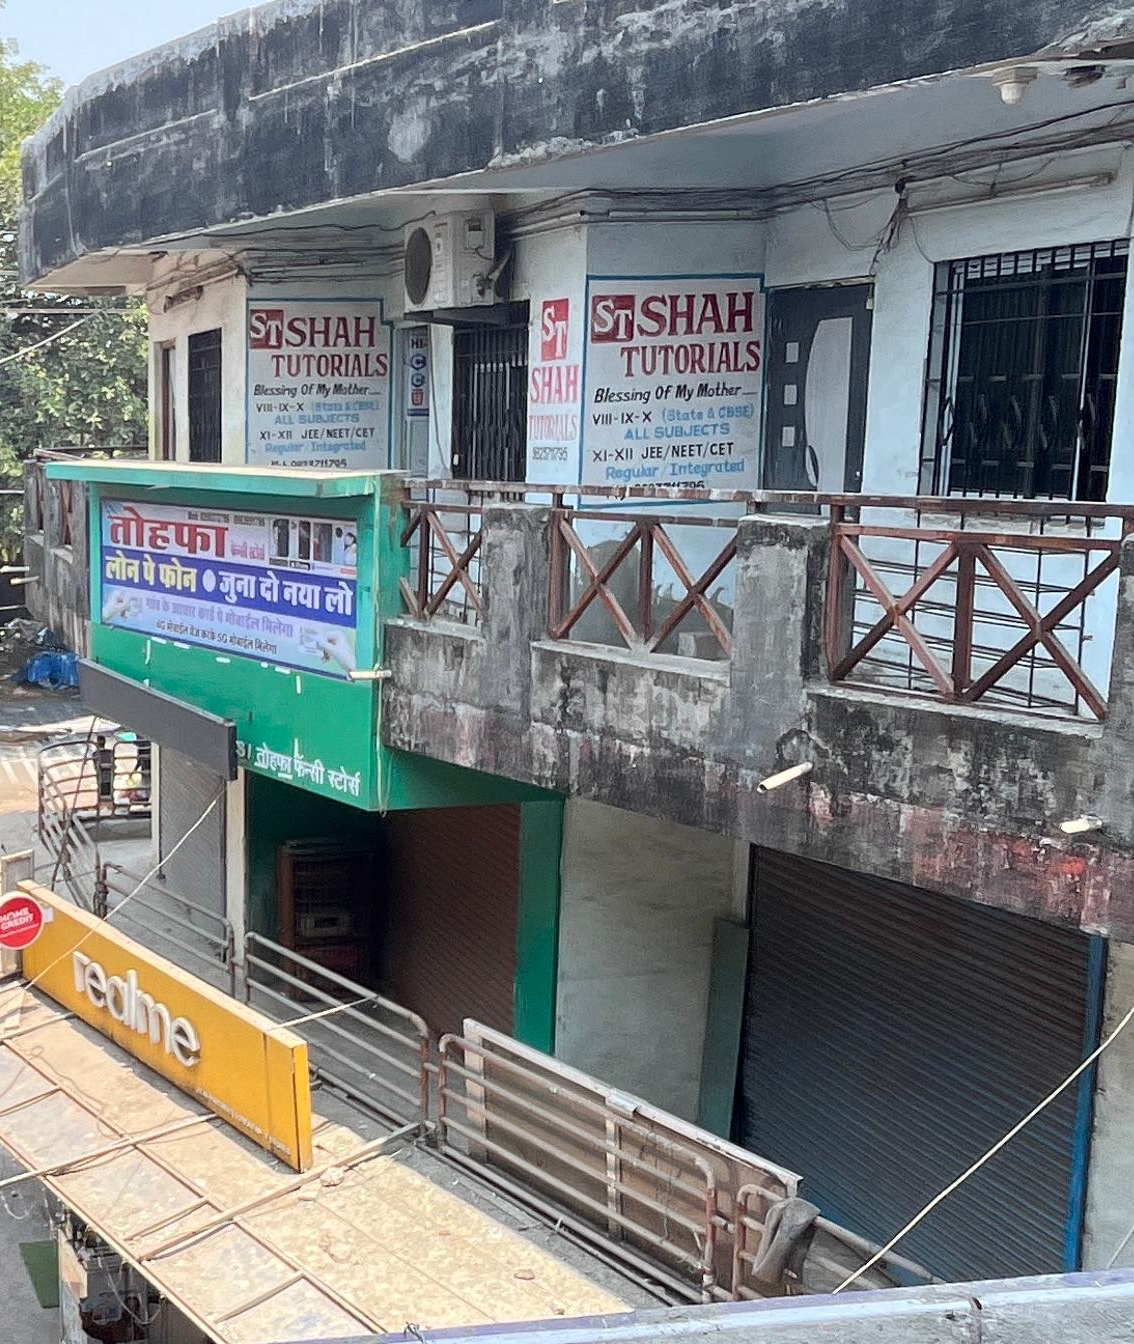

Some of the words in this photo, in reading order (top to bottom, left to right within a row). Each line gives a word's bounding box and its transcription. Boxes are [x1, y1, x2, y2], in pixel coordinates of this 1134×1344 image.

[637, 292, 754, 337] SHAH
[285, 317, 376, 347] SHAH
[271, 353, 388, 377] TUTORIALS
[621, 340, 761, 377] TUTORIALS
[253, 384, 297, 398] Blessing
[301, 384, 314, 396] Of
[316, 384, 331, 398] My
[530, 364, 579, 405] SHAH
[594, 387, 650, 404] Blessing
[655, 384, 672, 400] Of
[675, 384, 694, 402] My
[697, 382, 742, 398] Mother
[274, 415, 294, 425] ALL
[298, 414, 360, 424] SUBJECTS
[529, 414, 578, 441] TUTORIALS
[624, 428, 648, 441] ALL
[654, 423, 730, 439] SUBJECTS
[641, 442, 734, 460] JEE/NEET/CET
[606, 463, 659, 482] Regular
[670, 459, 744, 478] Integrated
[108, 506, 229, 558] तोहफा
[105, 550, 140, 583] लोन
[143, 554, 155, 586] पे
[159, 557, 197, 592] फोन
[218, 570, 256, 604] जुना
[259, 570, 279, 603] दो
[282, 581, 321, 610] नया
[324, 581, 354, 616] लो
[73, 950, 202, 1068] realme
